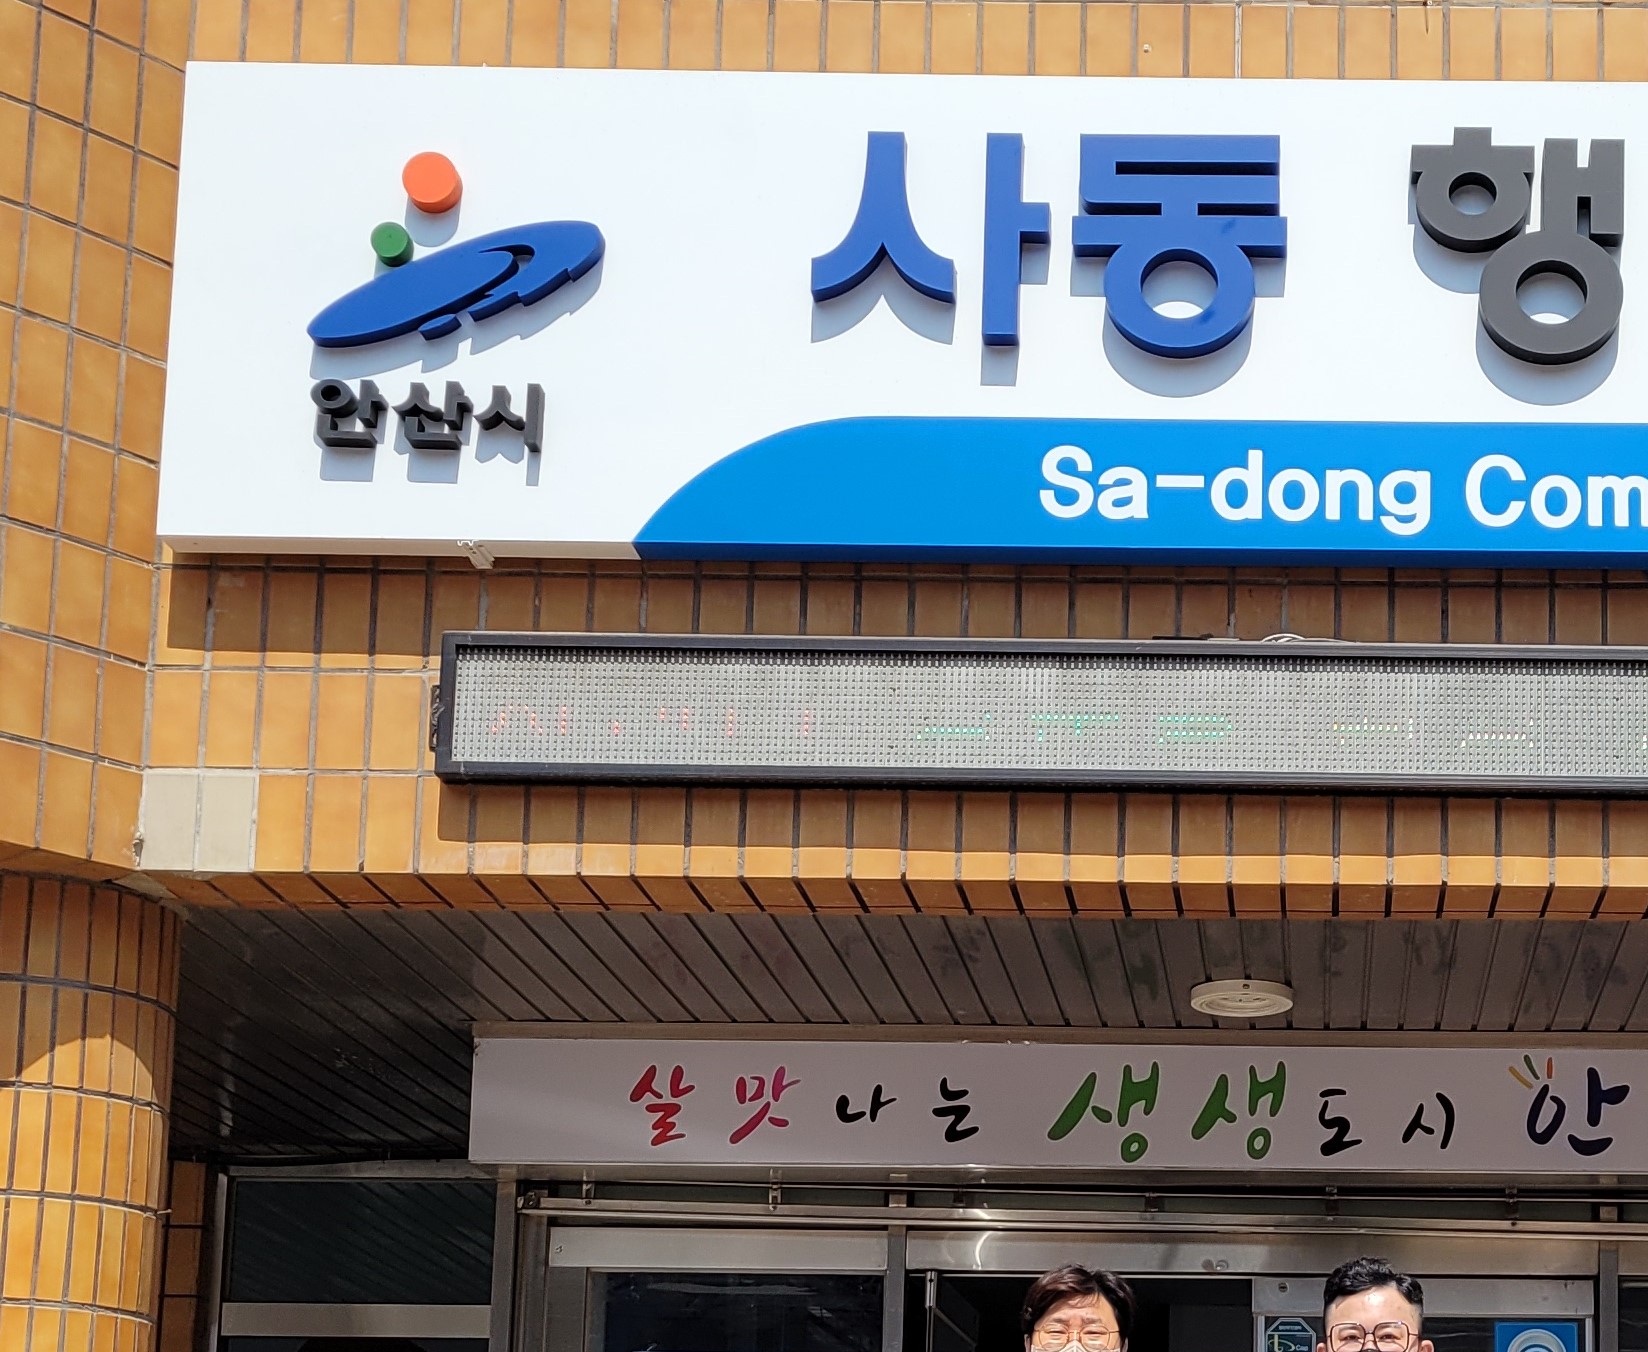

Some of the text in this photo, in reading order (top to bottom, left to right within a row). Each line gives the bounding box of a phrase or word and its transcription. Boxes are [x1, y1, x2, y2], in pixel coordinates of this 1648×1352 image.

[811, 131, 1288, 359] 사동
[311, 379, 544, 453] 안산시
[1040, 445, 1431, 534] Sa-dong
